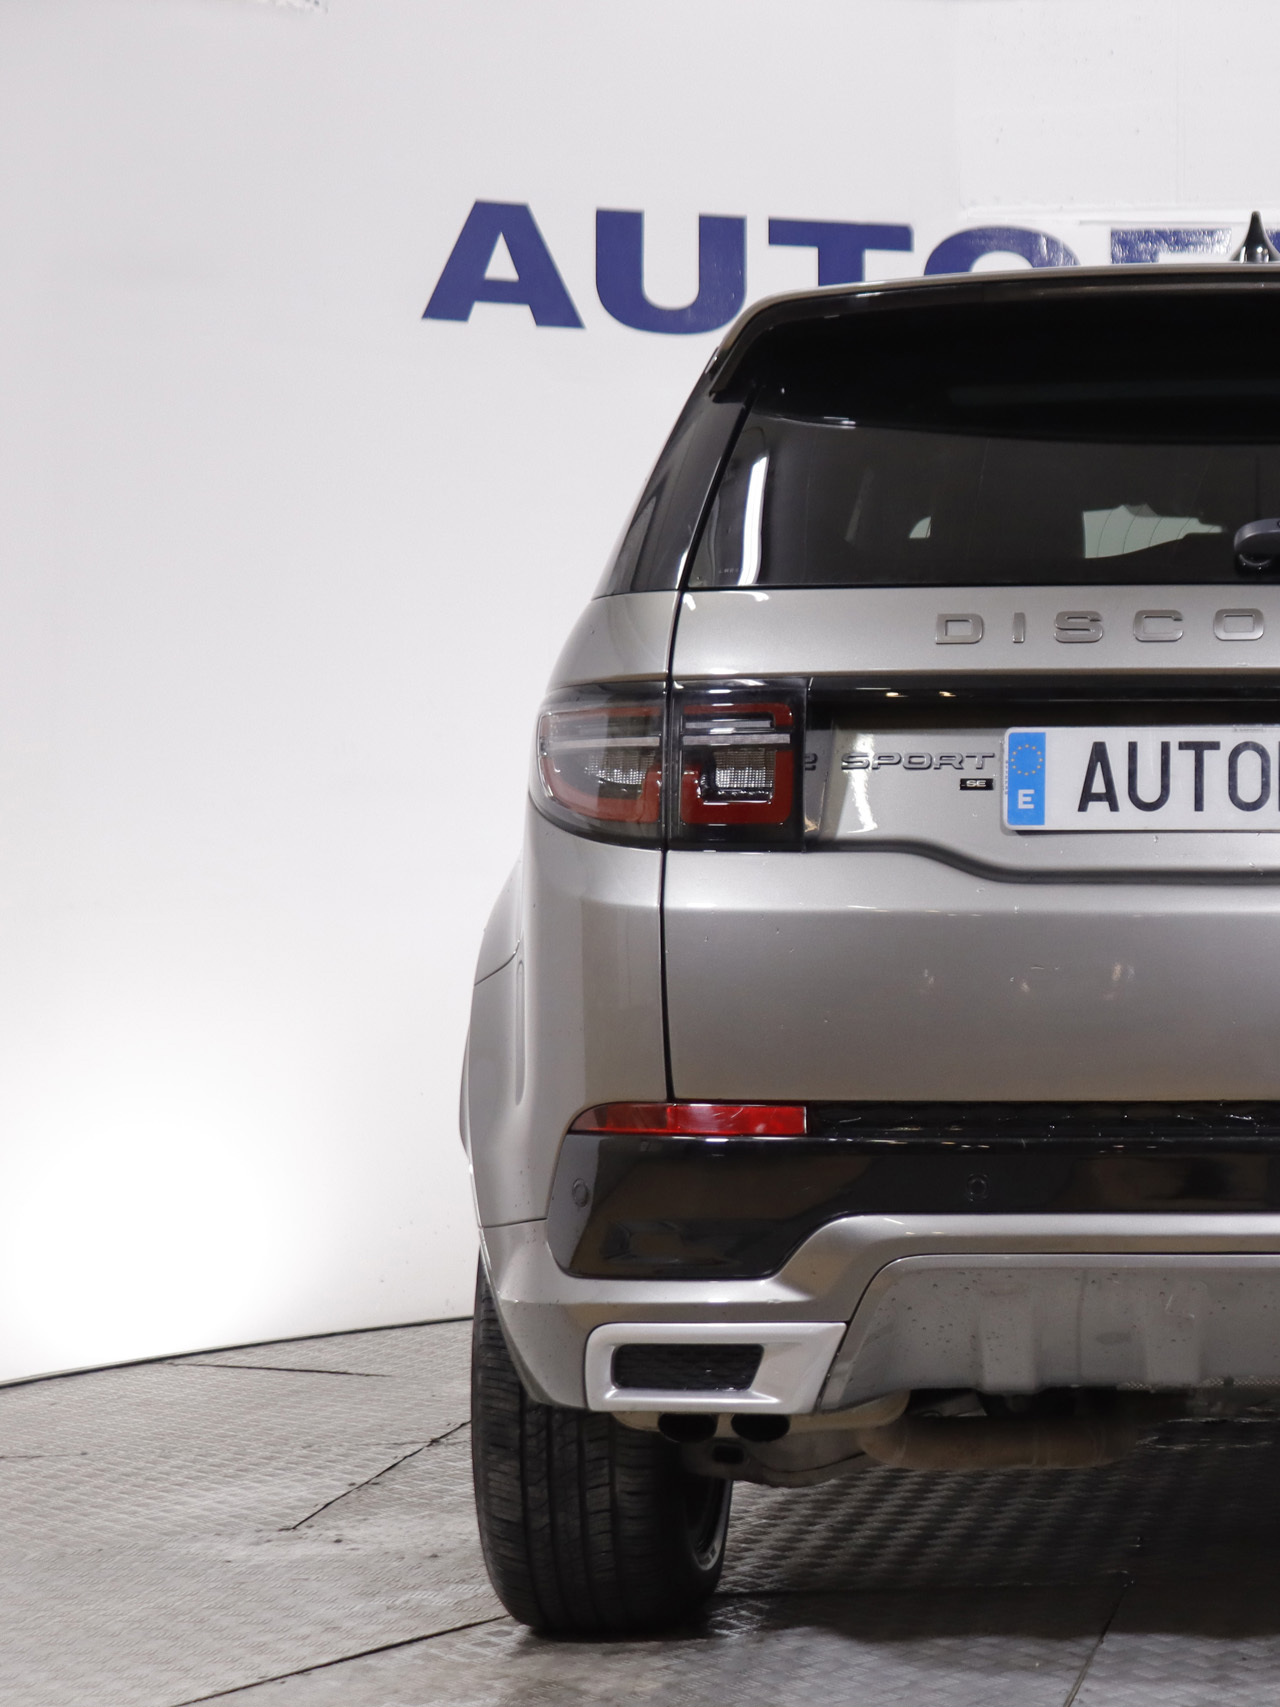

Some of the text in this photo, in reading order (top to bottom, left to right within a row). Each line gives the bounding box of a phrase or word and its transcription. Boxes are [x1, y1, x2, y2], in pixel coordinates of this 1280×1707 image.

[841, 752, 995, 771] SPORT
[966, 780, 987, 788] SE
[1017, 789, 1035, 810] E
